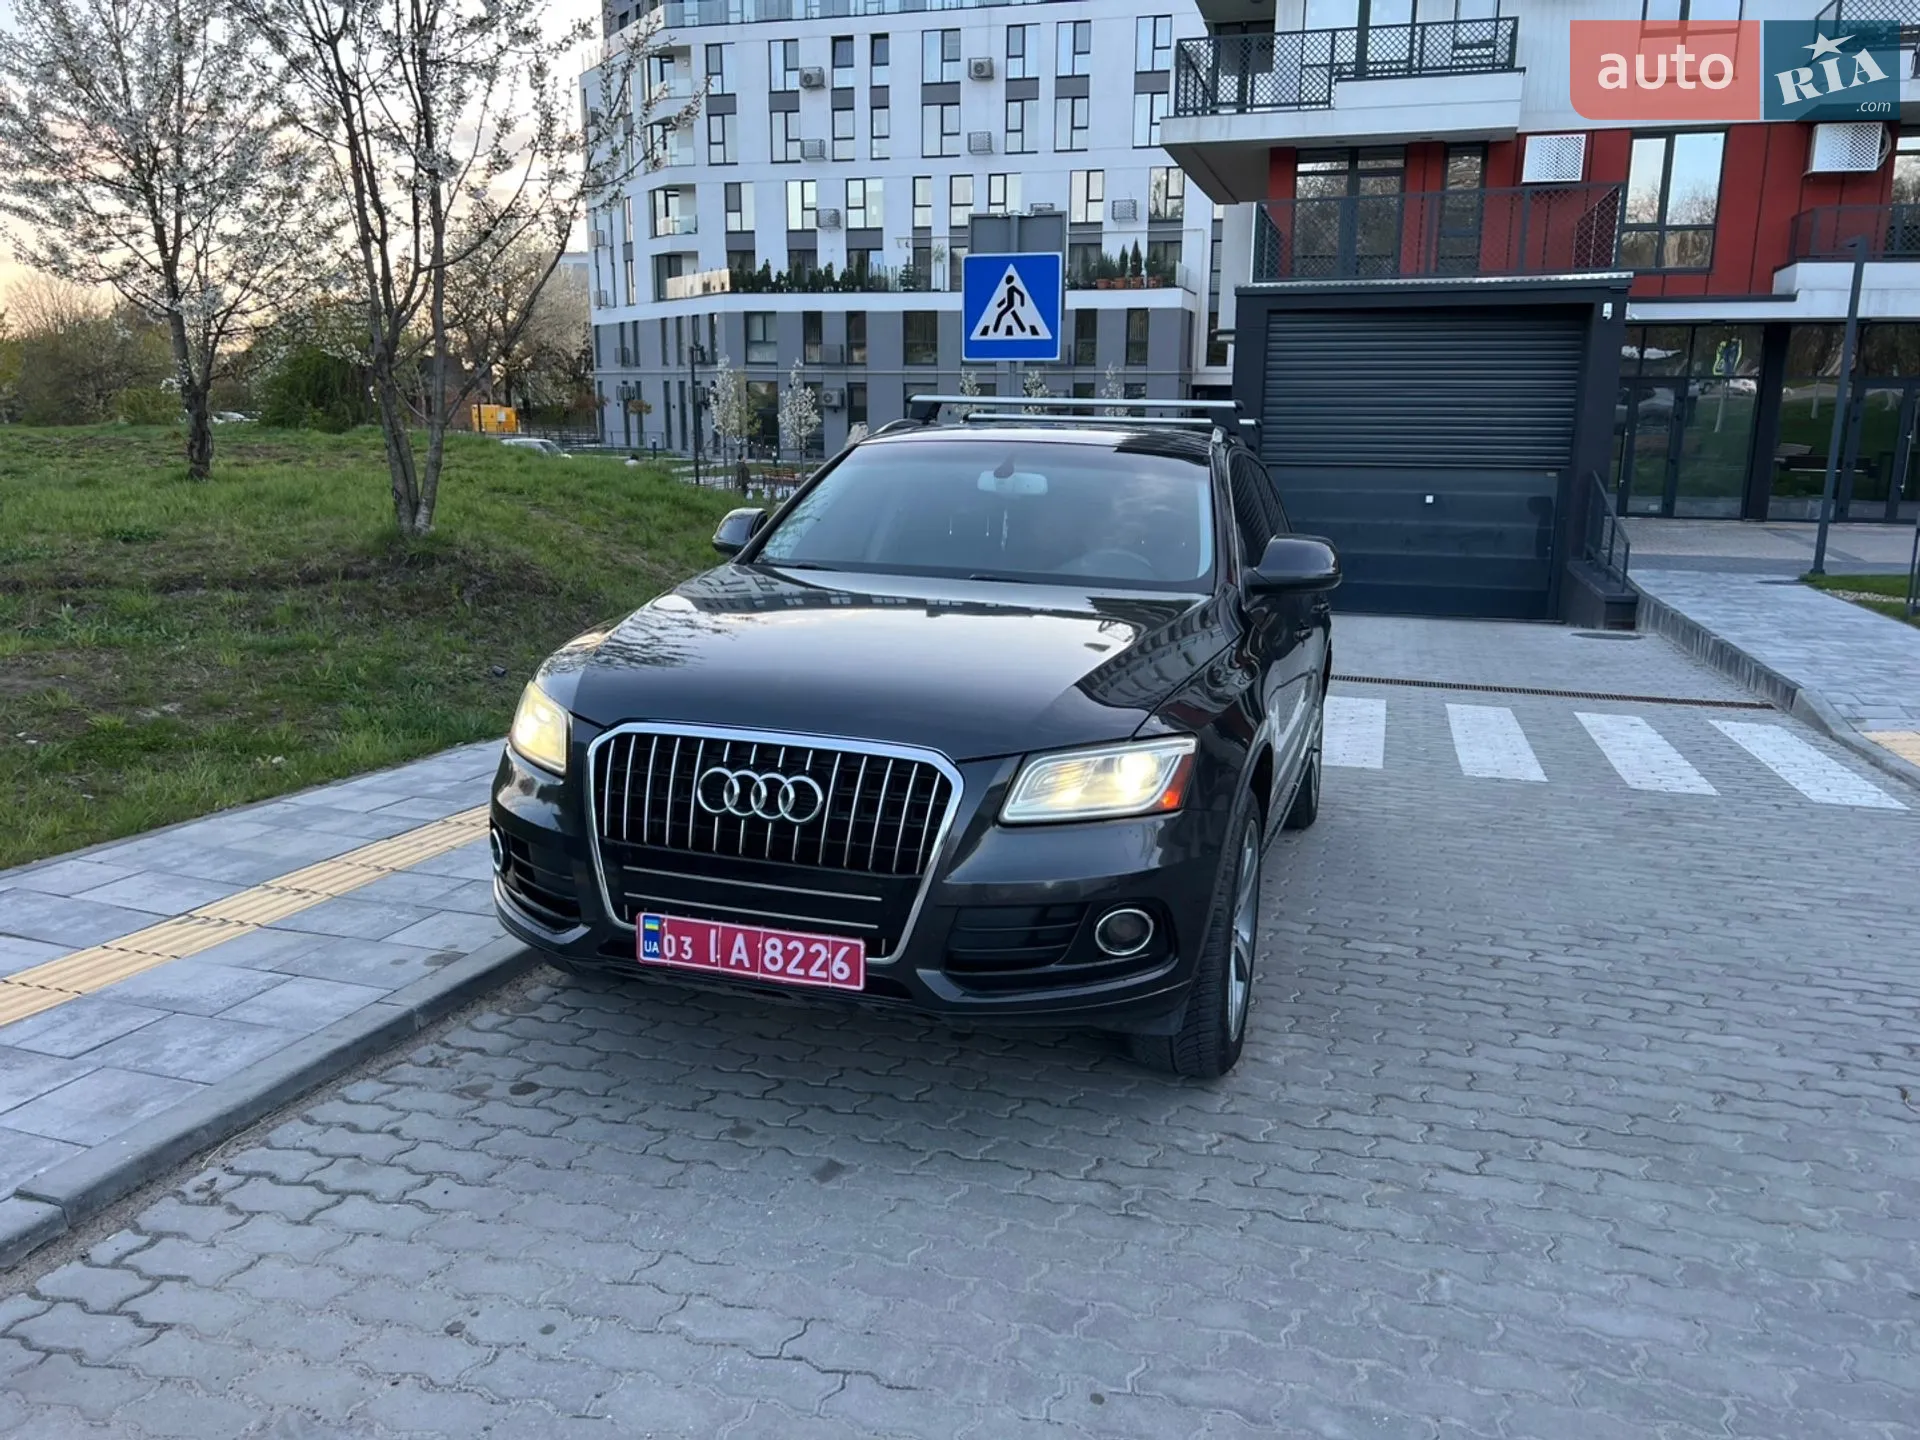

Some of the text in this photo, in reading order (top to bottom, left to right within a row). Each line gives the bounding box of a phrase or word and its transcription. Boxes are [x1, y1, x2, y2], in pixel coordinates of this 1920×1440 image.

[644, 940, 660, 954] UA
[663, 934, 693, 960] 03
[763, 937, 850, 980] 8226
